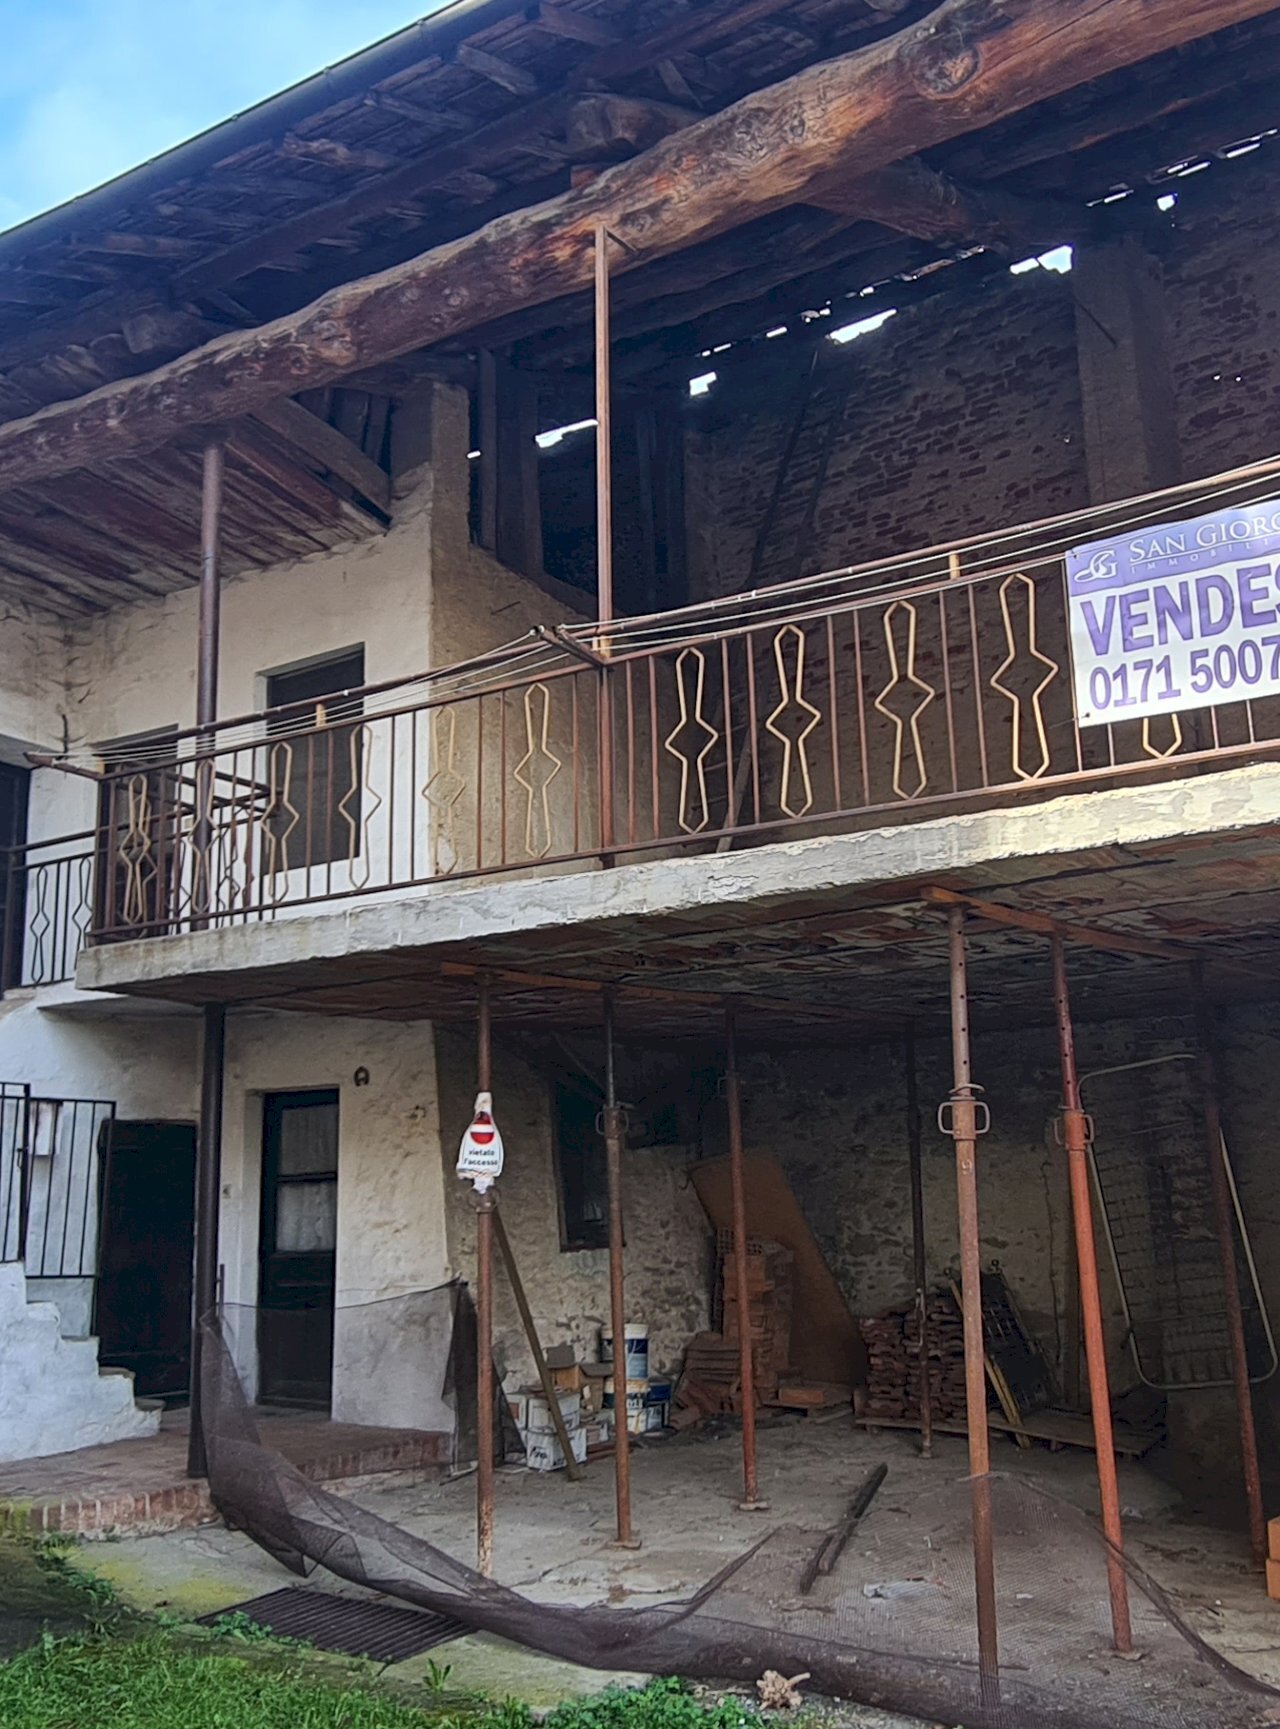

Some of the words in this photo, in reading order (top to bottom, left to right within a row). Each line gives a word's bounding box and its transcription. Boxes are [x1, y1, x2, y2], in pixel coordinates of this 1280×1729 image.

[1129, 533, 1185, 563] SAN
[1089, 654, 1182, 711] 0171
[468, 1148, 495, 1157] vietato
